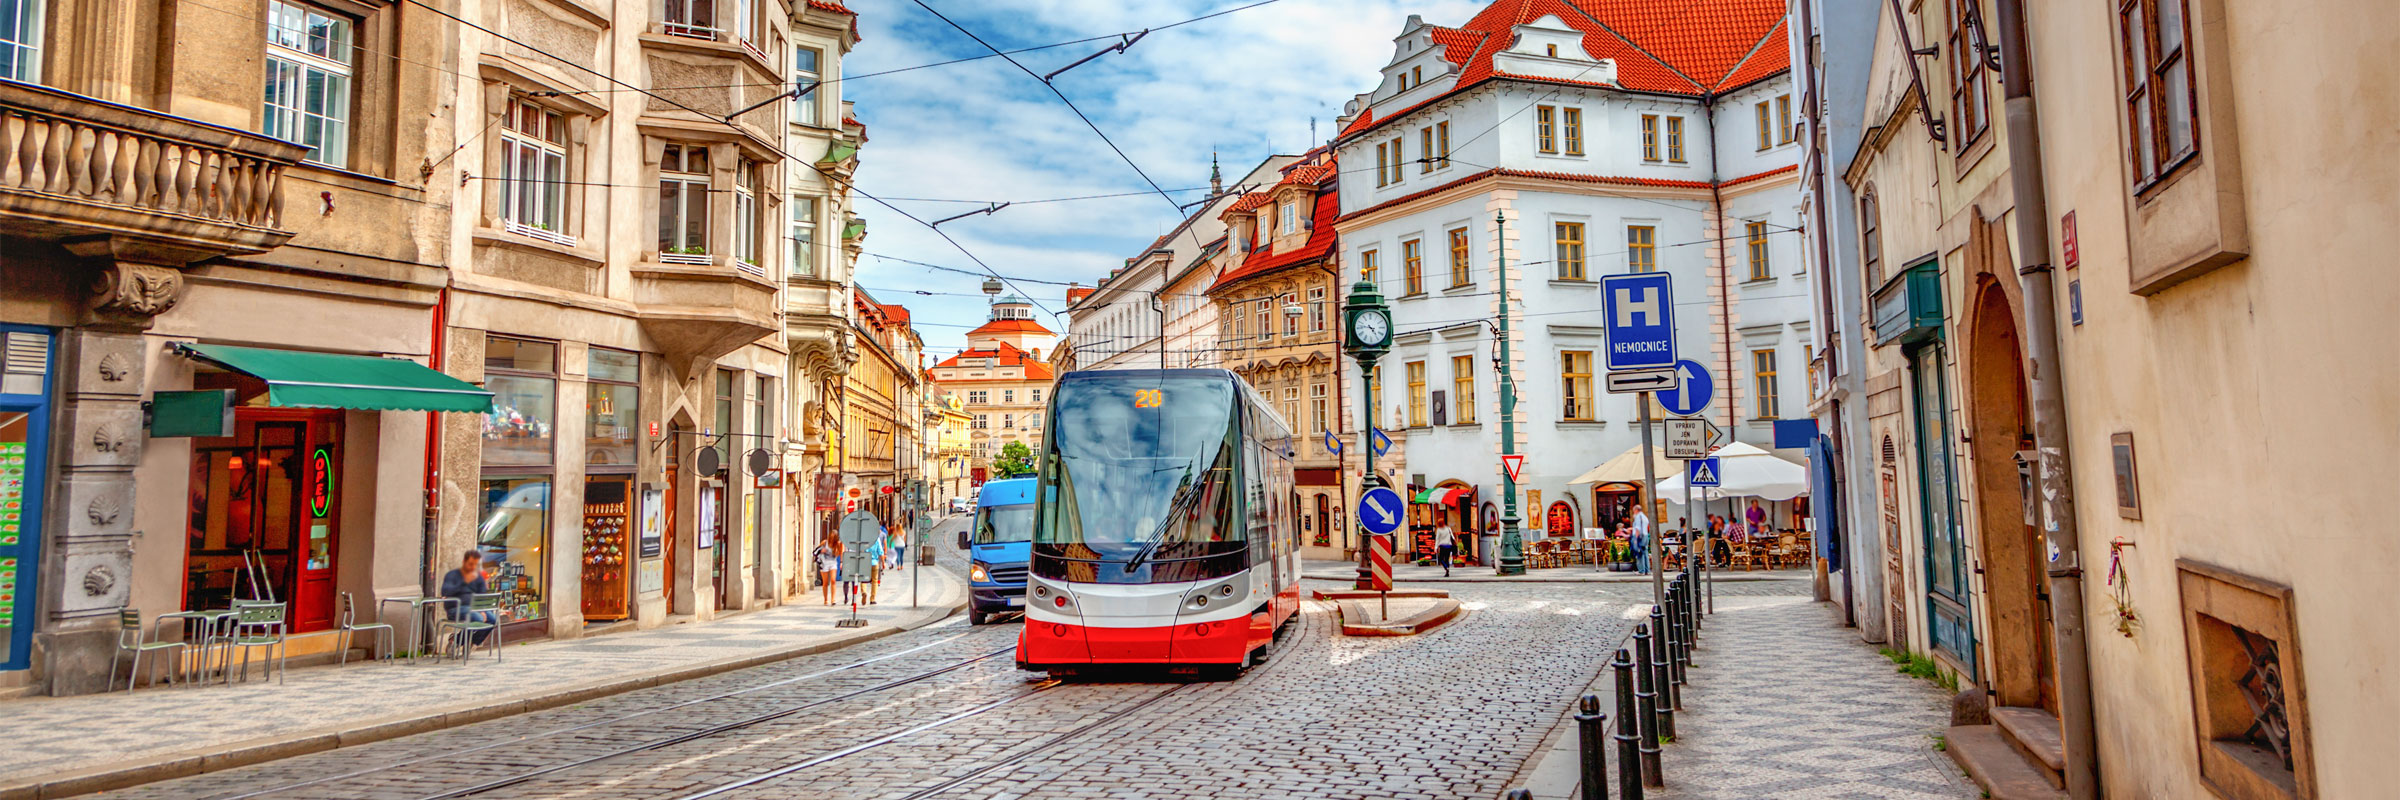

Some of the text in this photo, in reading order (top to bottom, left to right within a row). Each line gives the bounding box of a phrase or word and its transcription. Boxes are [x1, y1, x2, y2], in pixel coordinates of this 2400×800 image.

[1615, 287, 1661, 327] H
[1614, 340, 1668, 353] NEMOCNICE
[1135, 389, 1162, 408] 20
[315, 458, 325, 508] OPEN
